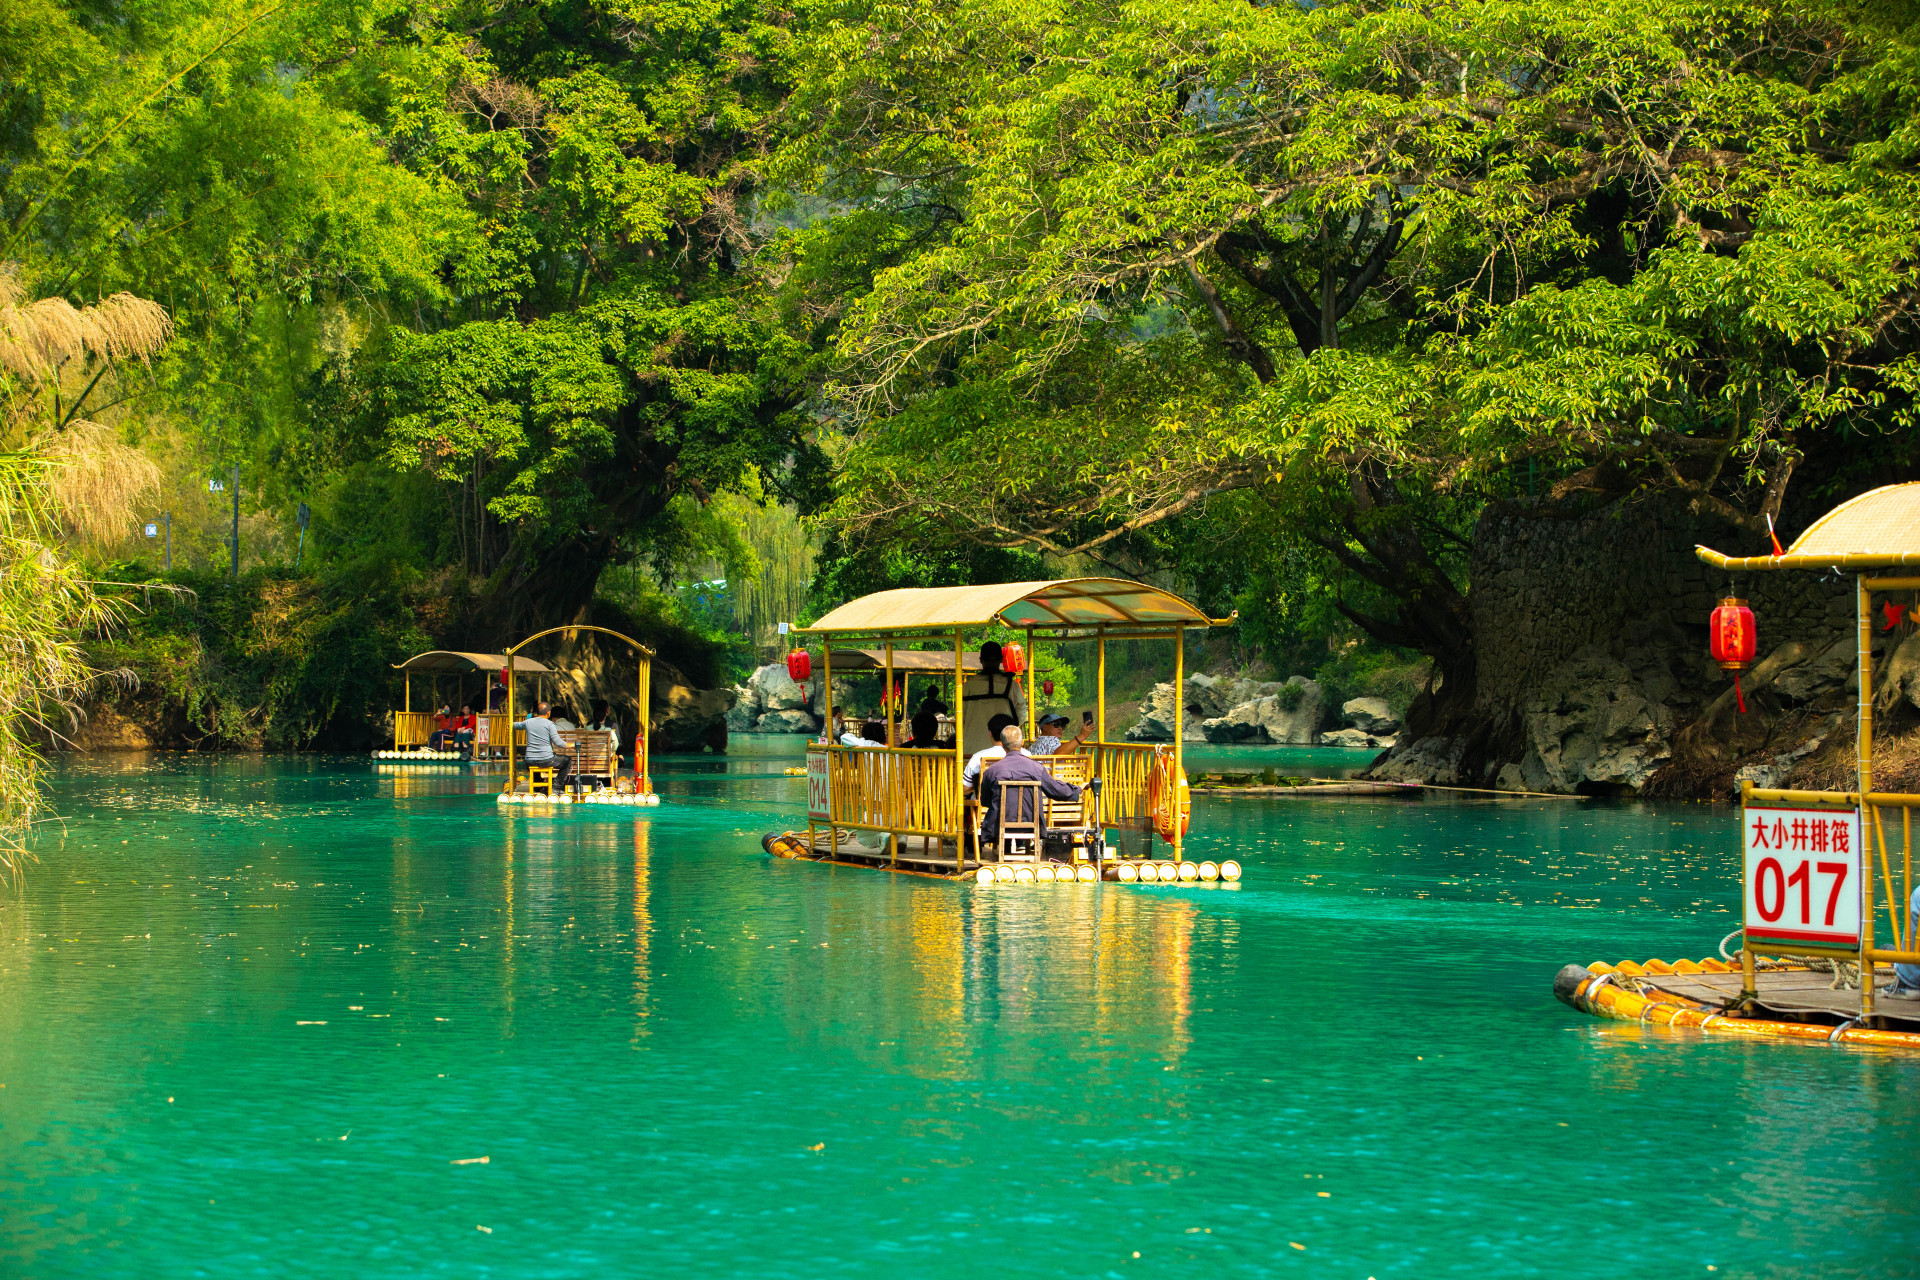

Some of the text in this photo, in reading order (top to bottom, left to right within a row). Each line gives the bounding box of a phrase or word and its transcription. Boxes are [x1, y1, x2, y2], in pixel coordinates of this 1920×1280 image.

[808, 776, 828, 811] 014
[1751, 815, 1850, 854] 大小井排筏
[1754, 856, 1849, 927] 017
